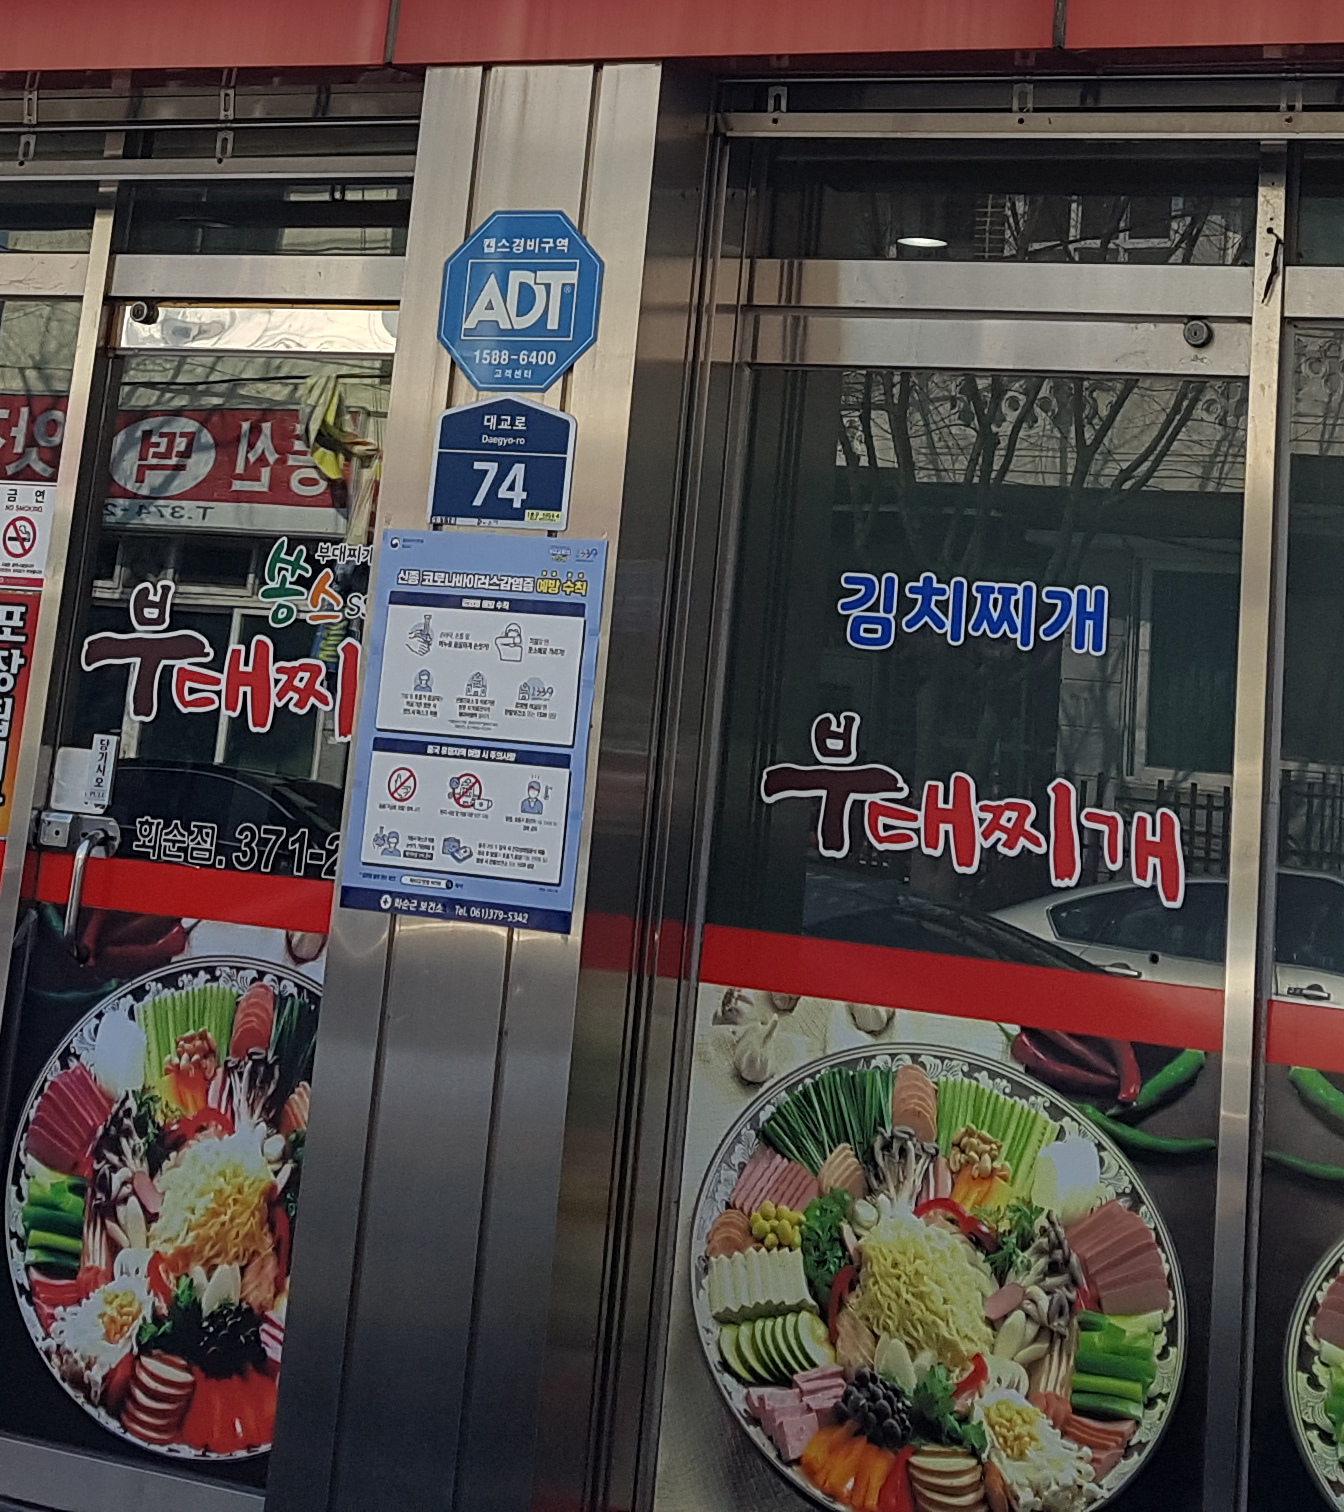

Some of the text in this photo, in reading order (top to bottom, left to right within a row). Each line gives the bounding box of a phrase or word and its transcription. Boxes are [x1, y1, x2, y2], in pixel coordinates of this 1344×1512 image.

[483, 237, 569, 253] 캡스경비구역
[463, 270, 578, 330] ADT
[474, 350, 556, 365] 1588-6400
[483, 414, 527, 430] 대교로
[471, 461, 528, 509] 74
[397, 569, 420, 586] 신종
[837, 571, 1109, 656] 김치찌개
[94, 738, 111, 788] 당기시오
[760, 711, 1186, 909] 부대찌개
[418, 899, 445, 914] 보건소
